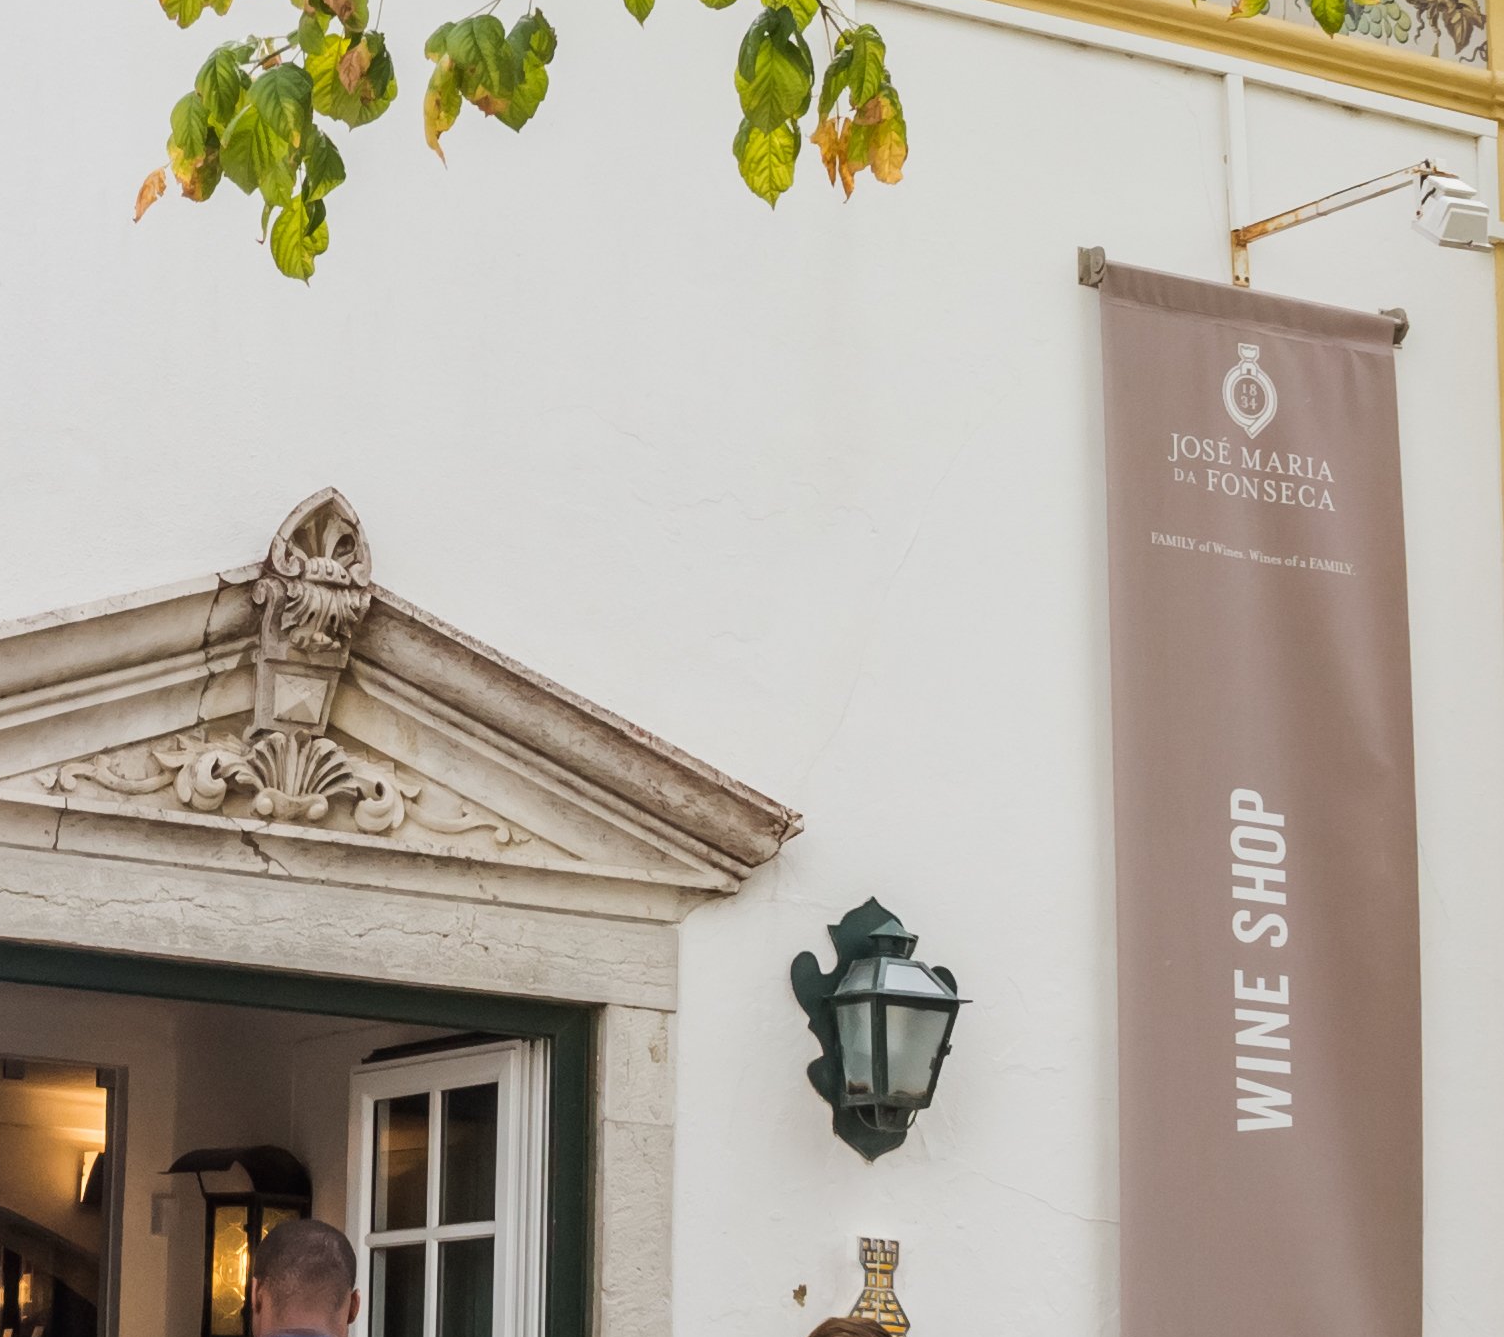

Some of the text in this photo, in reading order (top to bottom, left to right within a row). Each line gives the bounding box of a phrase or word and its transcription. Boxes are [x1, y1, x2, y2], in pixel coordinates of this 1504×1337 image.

[1167, 432, 1335, 483] JOSÉ MARIA
[1174, 467, 1336, 512] DA FONSECA
[1150, 531, 1356, 576] FAMILY of Wines. Wines of a FAMILY.
[1230, 787, 1293, 1132] WINE SHOP
